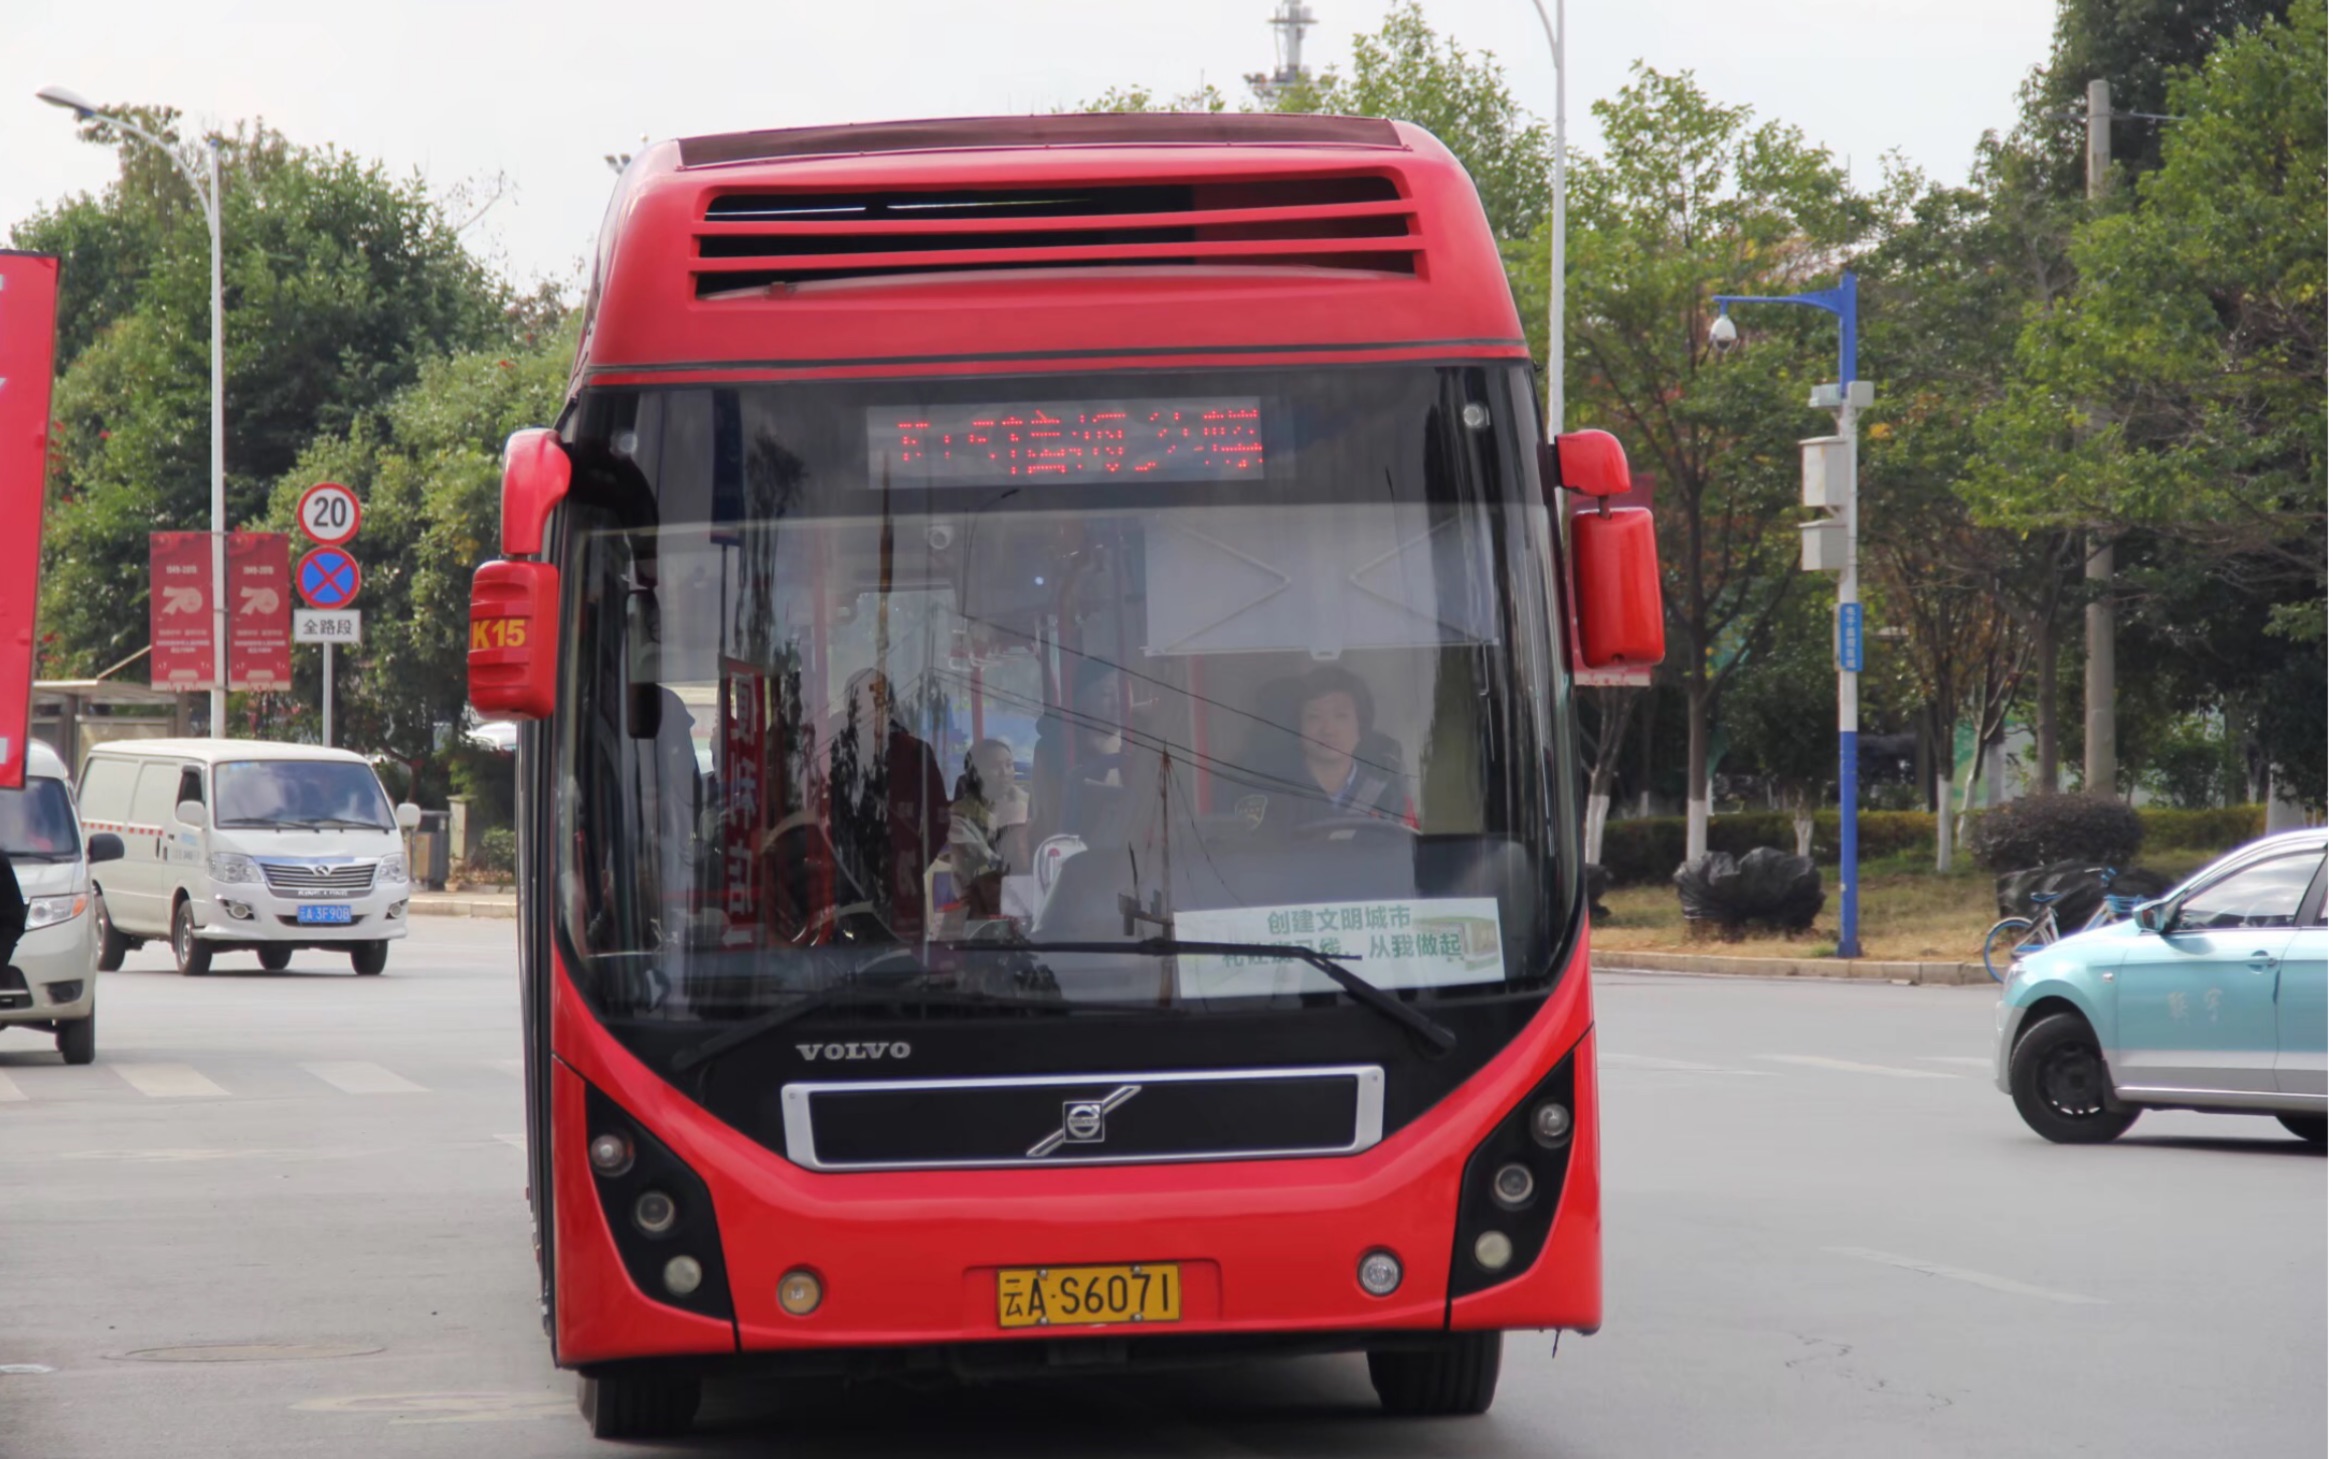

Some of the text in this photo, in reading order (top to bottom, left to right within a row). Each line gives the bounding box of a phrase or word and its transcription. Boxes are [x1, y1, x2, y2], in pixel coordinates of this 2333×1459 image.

[313, 497, 346, 528] 20
[303, 618, 353, 636] 全路段
[472, 619, 526, 650] K15
[1267, 905, 1411, 935] 创建文明城市
[795, 1041, 911, 1061] VOLVO
